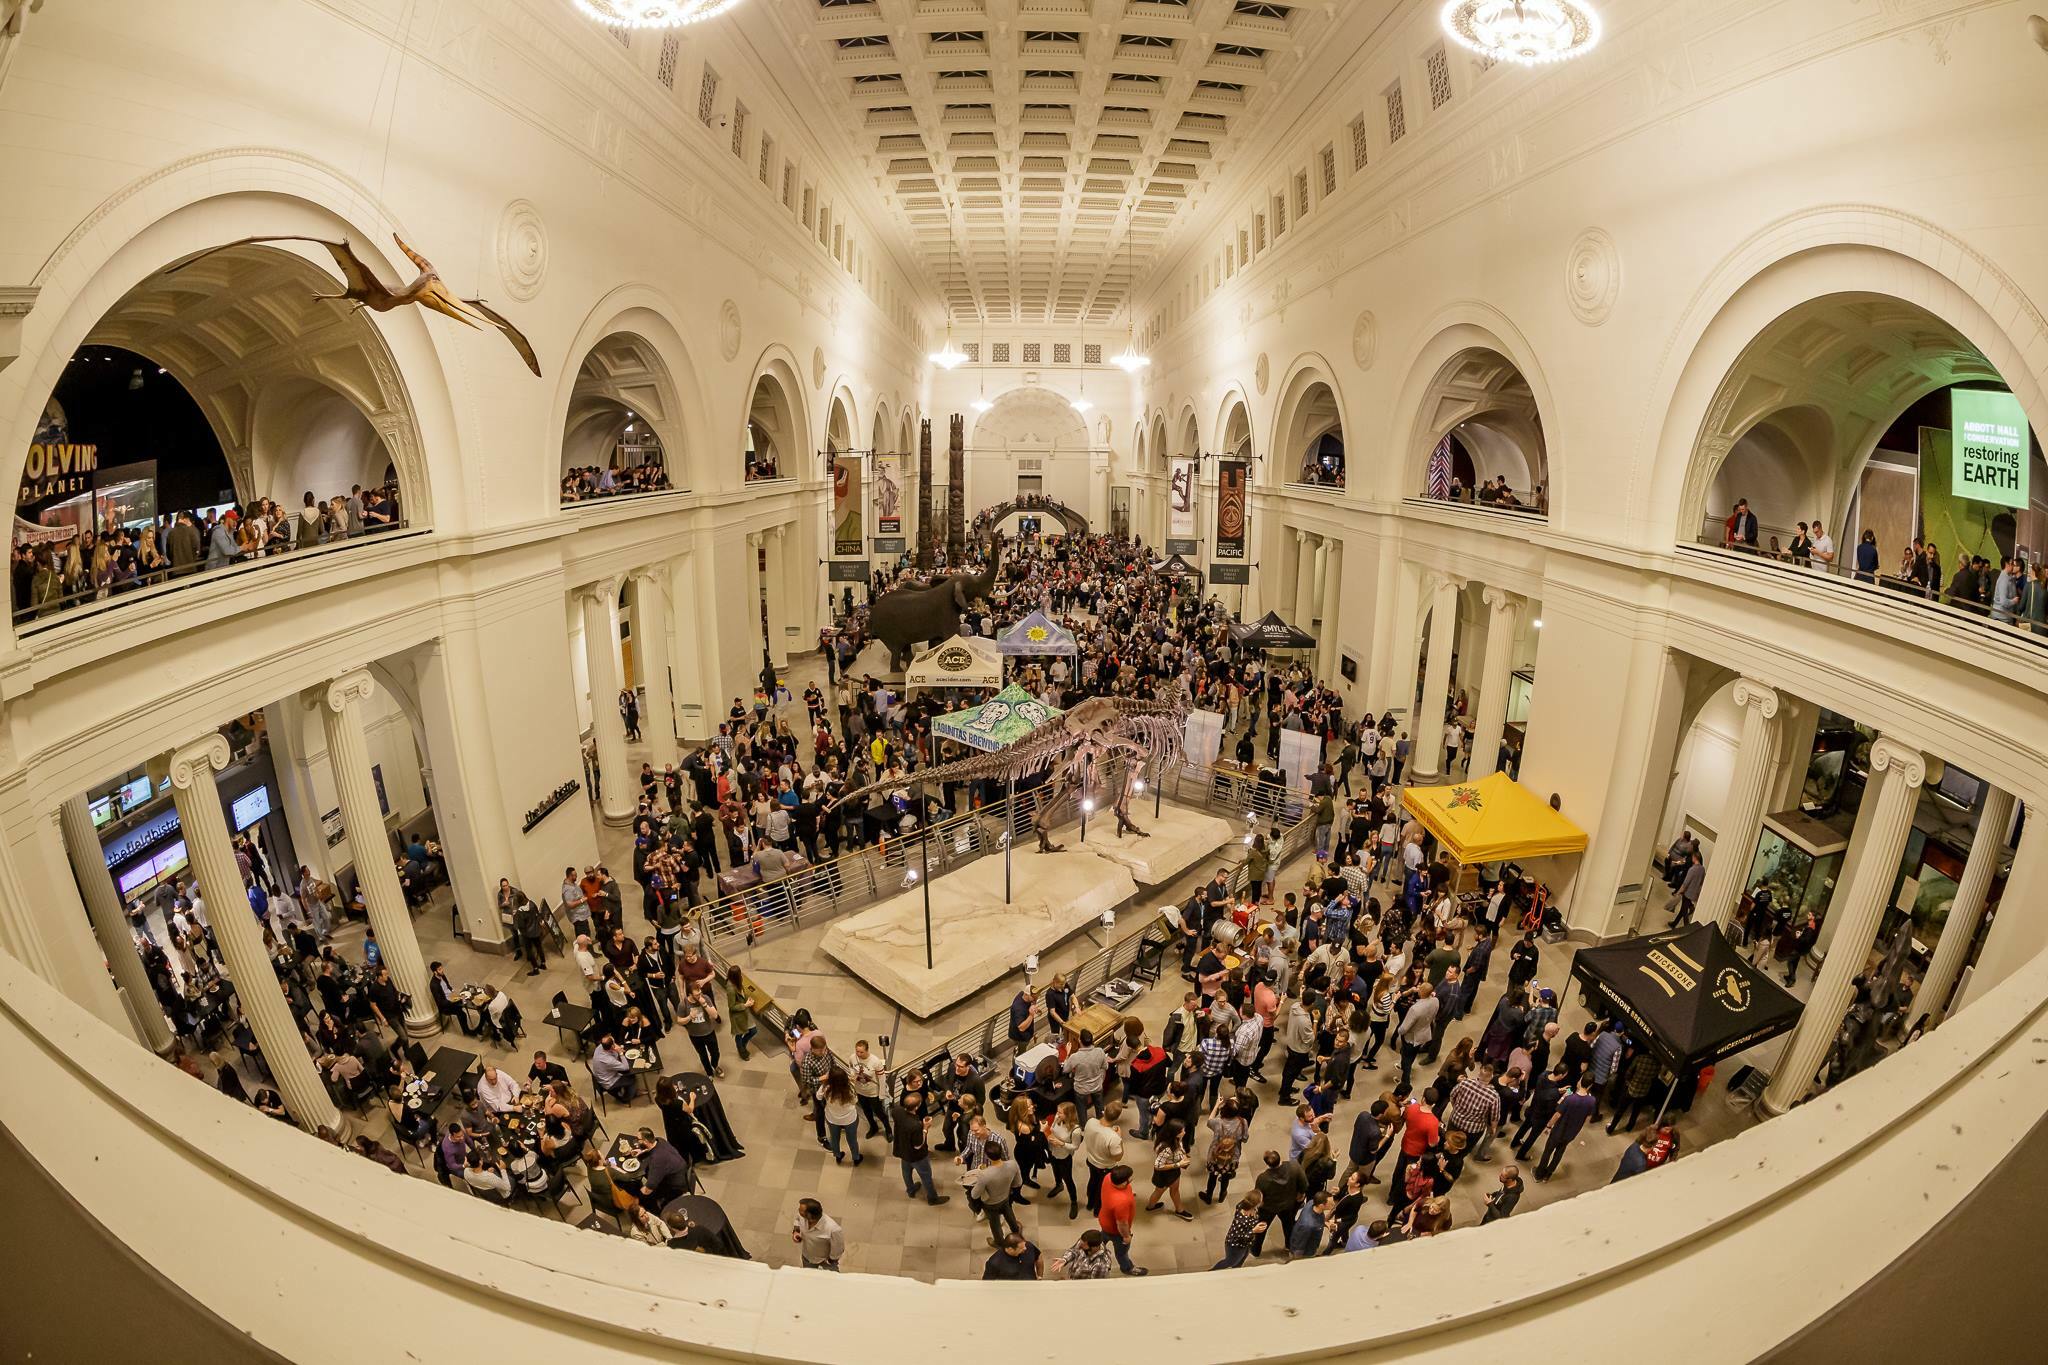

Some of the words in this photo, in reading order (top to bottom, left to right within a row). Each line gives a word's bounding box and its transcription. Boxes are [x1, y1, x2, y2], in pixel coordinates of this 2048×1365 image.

[1964, 445, 2020, 469] restoring
[1964, 462, 2019, 490] EARTH
[22, 477, 84, 501] PLANET
[836, 545, 862, 553] CHINA
[1217, 548, 1242, 556] PACIFIC
[1262, 625, 1288, 634] SMYLIE
[944, 656, 966, 664] ACE
[982, 676, 999, 684] ACE
[1650, 952, 1693, 988] BRICKSTONE
[1599, 981, 1631, 1014] BRICKSTONE
